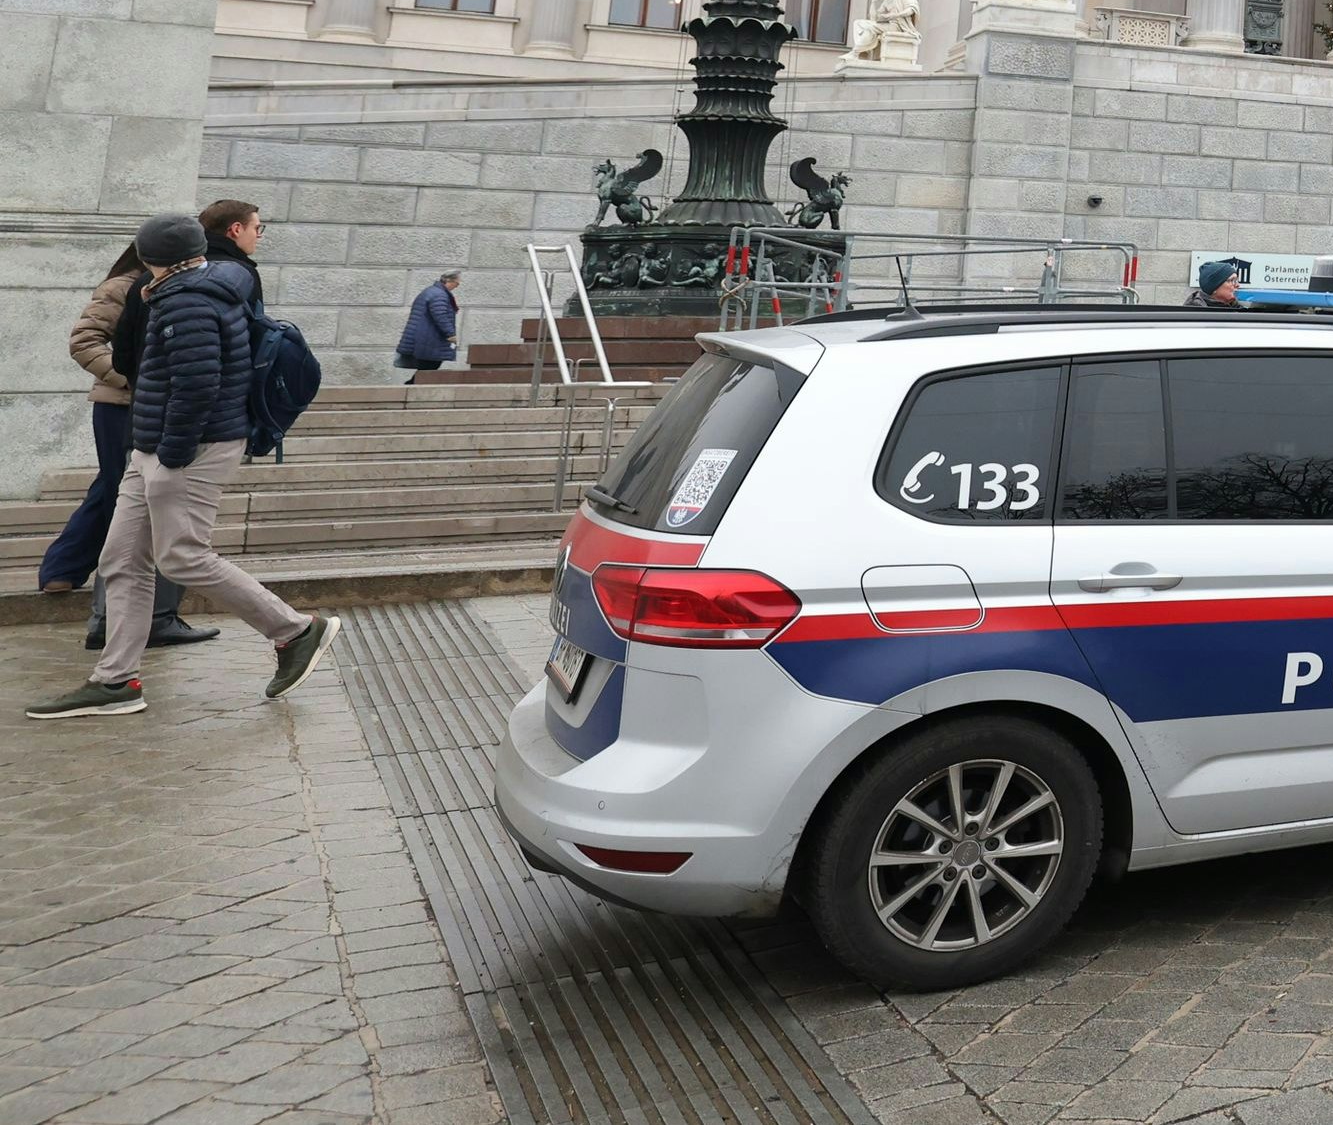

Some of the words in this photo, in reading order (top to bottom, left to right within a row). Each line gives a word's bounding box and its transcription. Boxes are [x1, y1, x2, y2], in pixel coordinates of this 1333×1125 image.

[1264, 265, 1309, 274] Parlament
[1264, 275, 1309, 284] Österreich
[950, 463, 1040, 510] 133
